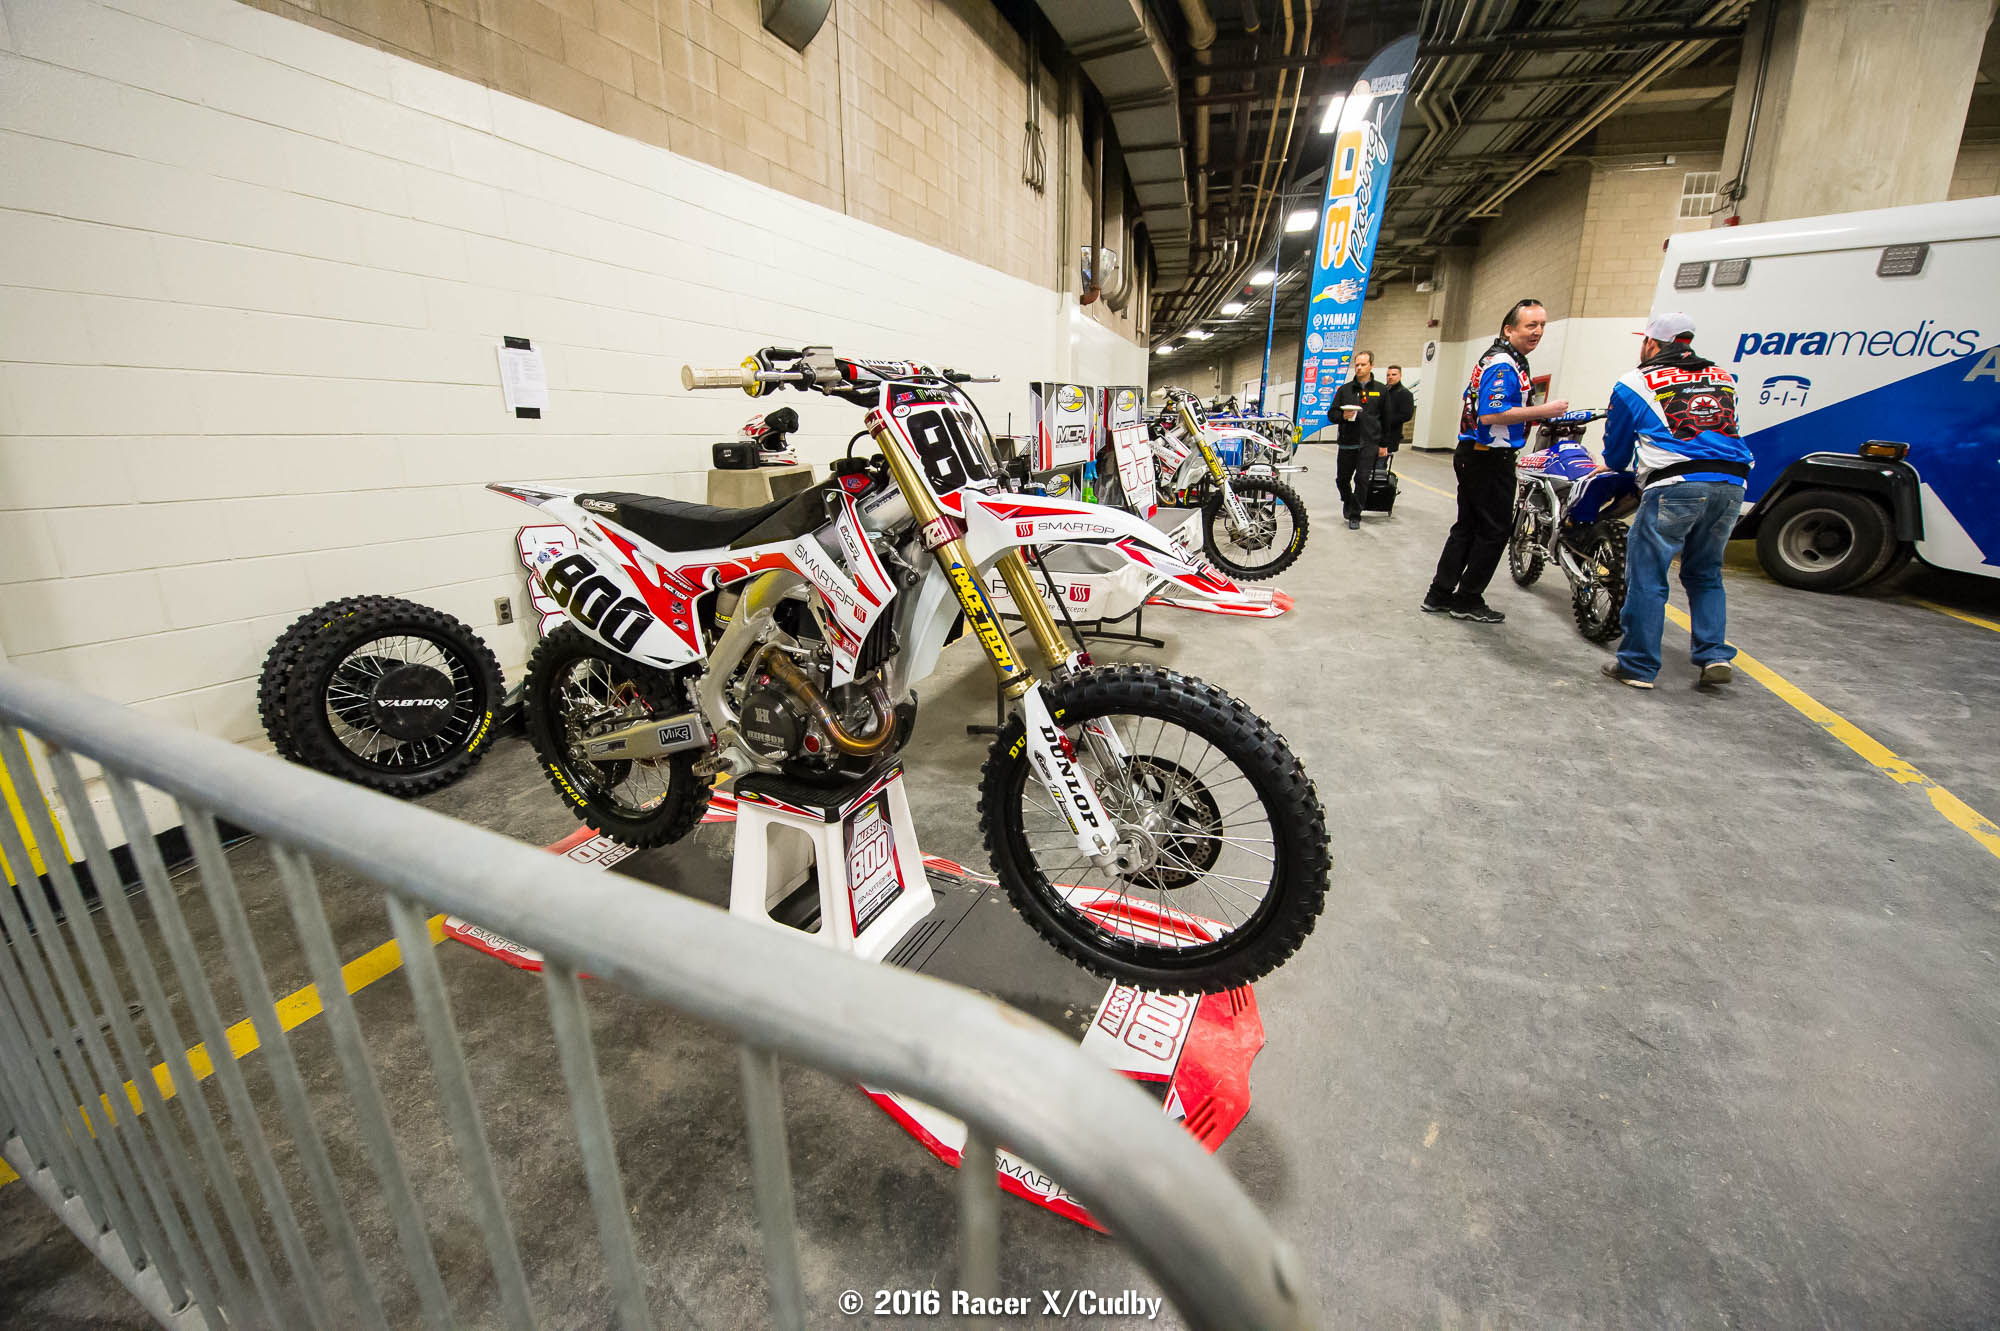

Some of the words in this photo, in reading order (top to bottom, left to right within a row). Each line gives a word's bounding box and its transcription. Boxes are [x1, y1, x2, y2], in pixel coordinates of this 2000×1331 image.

[1733, 319, 1981, 363] paramedics
[1038, 522, 1115, 534] SMARTOP
[544, 553, 655, 654] 800
[794, 543, 855, 608] SMARTOP
[950, 567, 989, 617] RACE
[978, 616, 1014, 667] TECH
[467, 711, 493, 753] DUNLOP
[549, 763, 589, 808] DUNLOP
[1040, 725, 1100, 828] DUNLOP
[850, 831, 889, 891] 800
[1123, 992, 1191, 1061] 800
